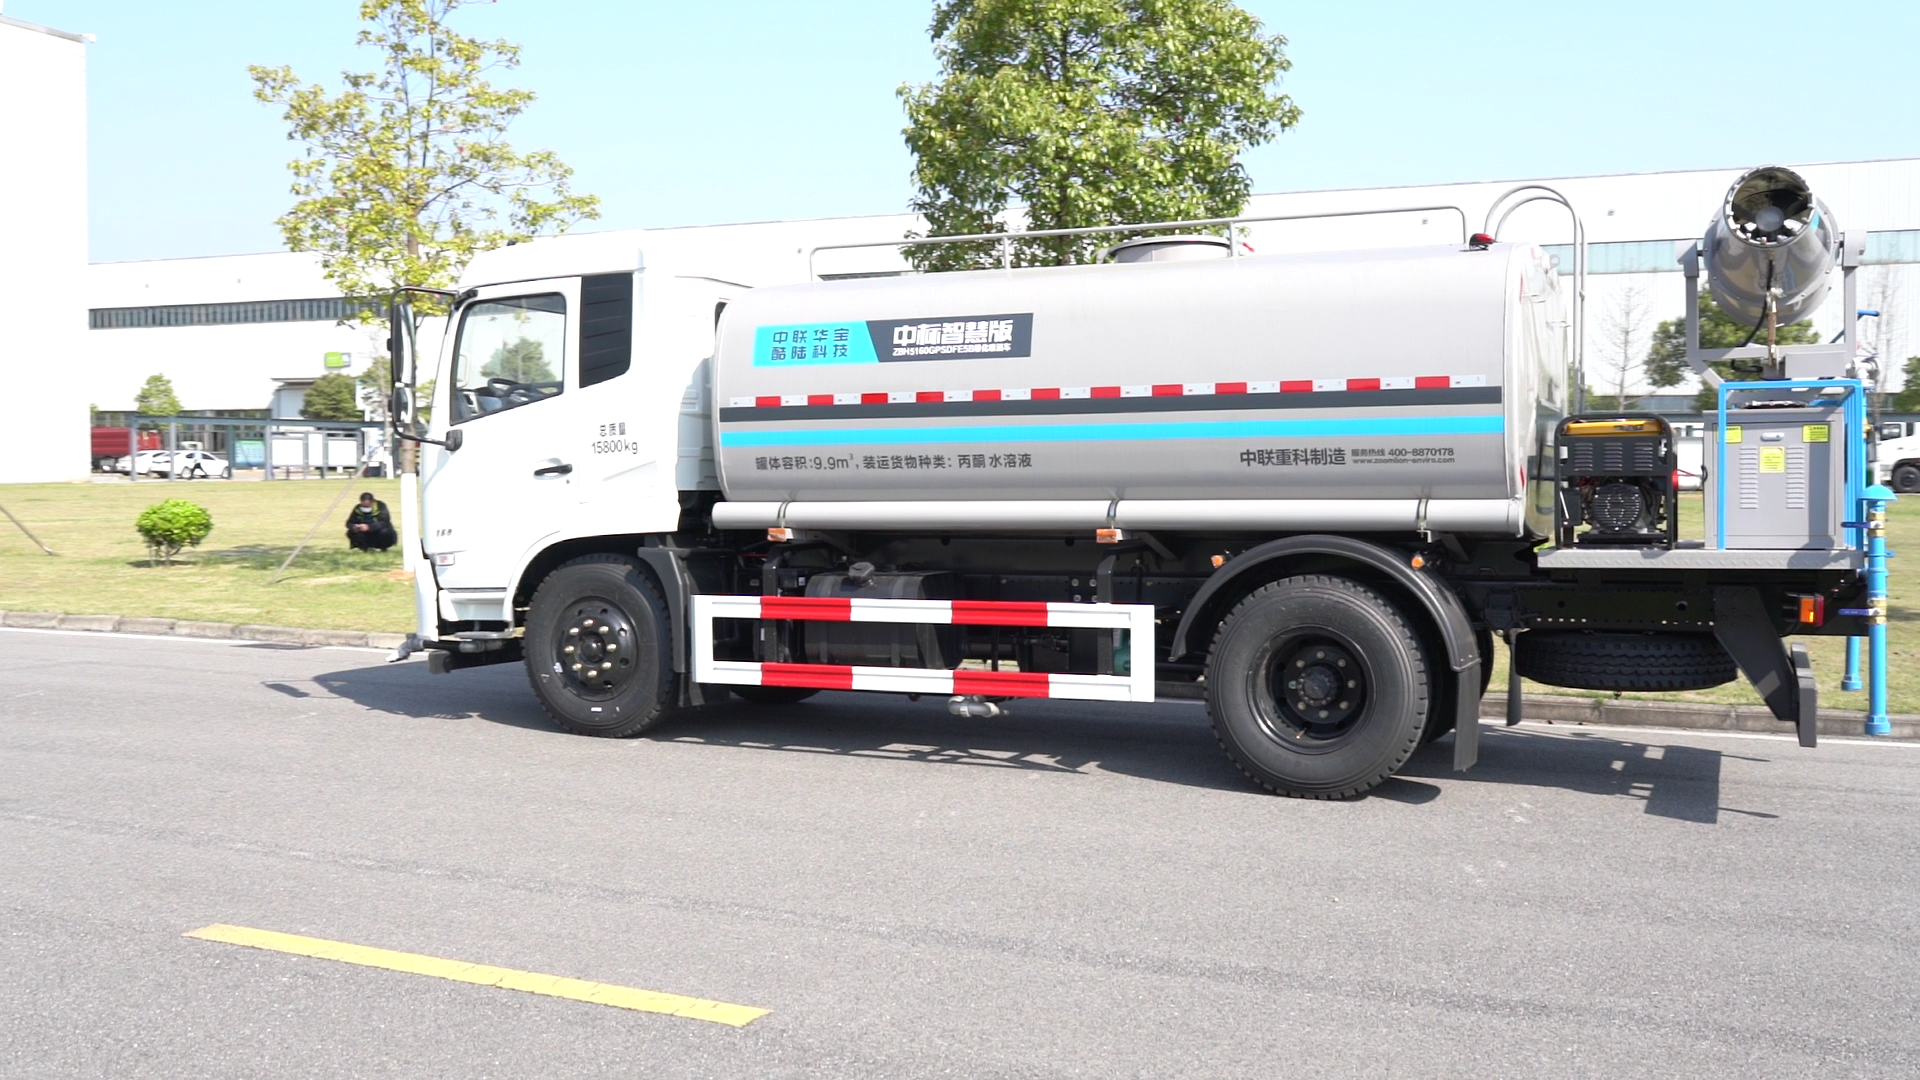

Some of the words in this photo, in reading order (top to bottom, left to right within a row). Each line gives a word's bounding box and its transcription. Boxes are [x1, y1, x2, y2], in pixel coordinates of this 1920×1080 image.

[772, 327, 850, 344] 中联华宝
[892, 319, 1014, 346] 中标智慧版
[771, 343, 849, 361] 酷陆科技
[599, 422, 627, 437] 总质量
[1239, 447, 1347, 467] 中联重科制造
[1352, 456, 1456, 465] www.zoomlion-enviro.com
[1388, 447, 1455, 457] 400-8870178
